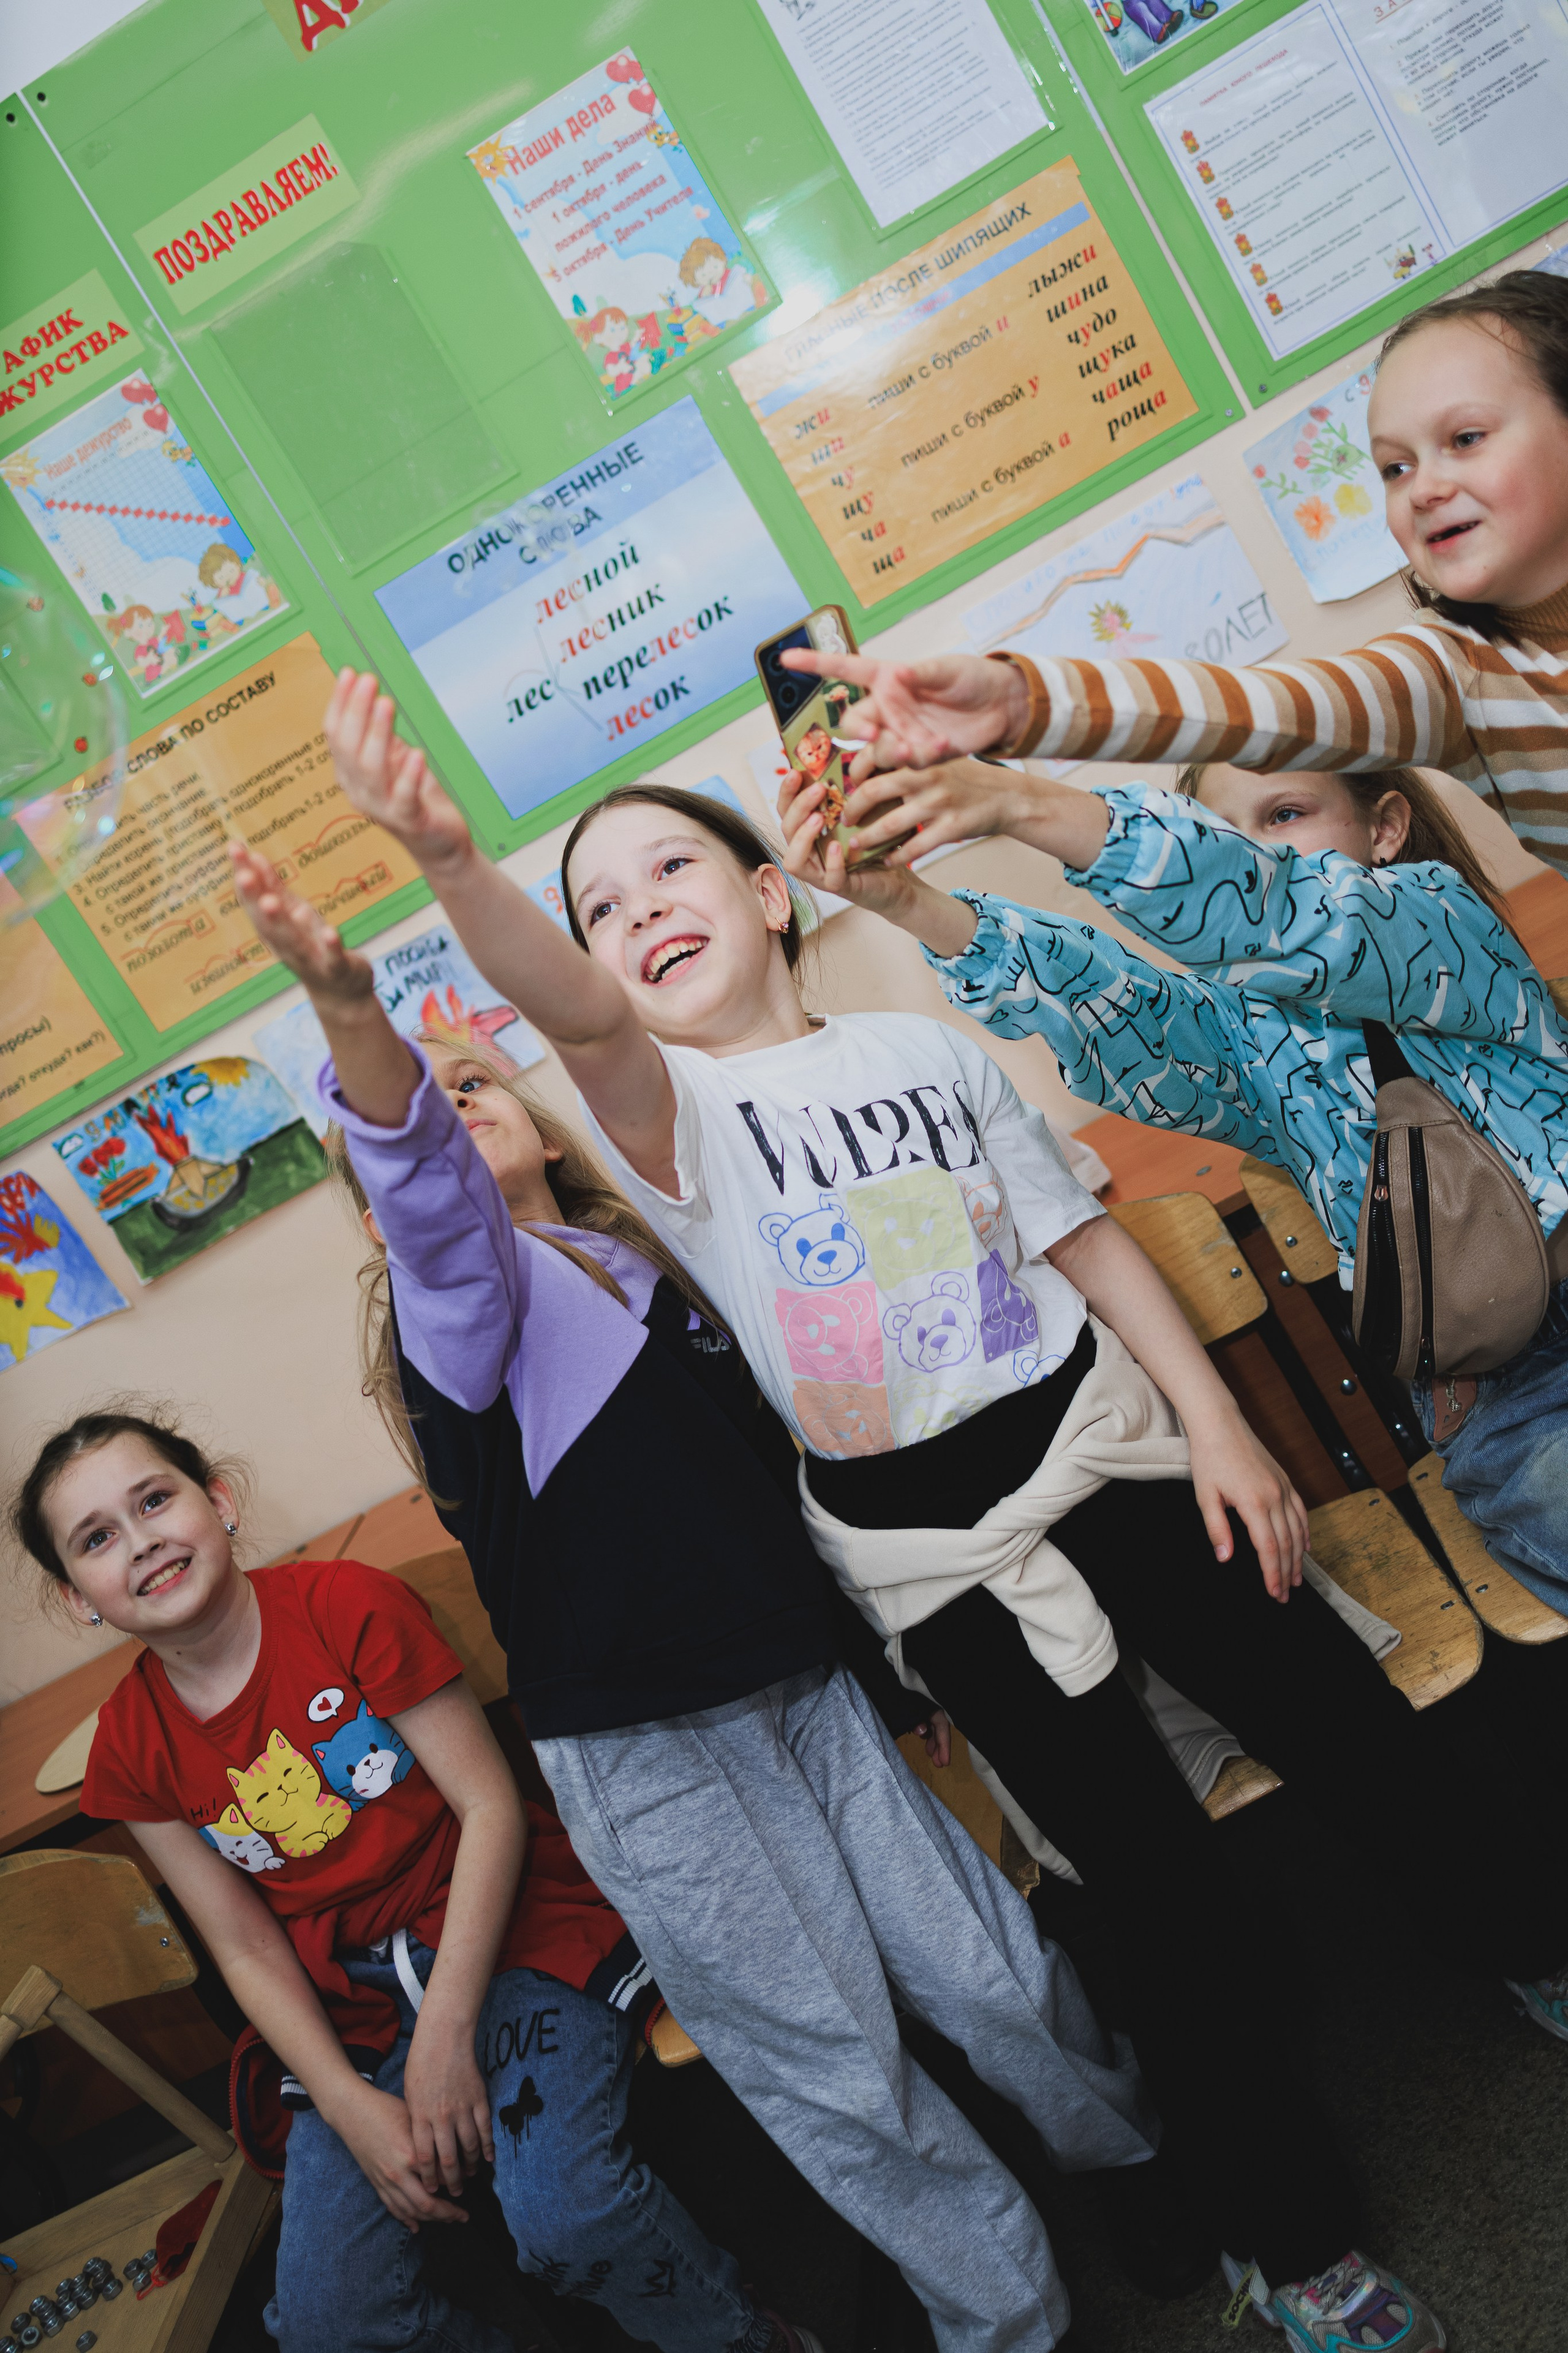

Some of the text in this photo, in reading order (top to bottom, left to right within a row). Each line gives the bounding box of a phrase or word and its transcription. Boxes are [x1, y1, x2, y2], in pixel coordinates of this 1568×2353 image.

[504, 94, 616, 174] Наши дела
[521, 175, 575, 213] сентября
[582, 151, 613, 176] День
[563, 184, 606, 217] октября
[616, 162, 643, 184] день
[156, 146, 336, 282] ПОЗДРАВЛЯЕМ!
[556, 175, 666, 251] пожилого человека
[564, 240, 608, 276] октября
[615, 221, 645, 244] День
[645, 186, 694, 221] Учителя
[936, 203, 1031, 269] ШИПЯЩИХ
[1030, 246, 1096, 297] лыжи
[1047, 276, 1108, 322] шина
[4, 310, 82, 373] АФИК
[930, 326, 992, 369] буквой
[1068, 309, 1117, 346] чудо
[1079, 334, 1136, 377] щука
[1093, 363, 1152, 403] чаща
[902, 433, 948, 466] пиши
[965, 385, 1025, 428] буквой
[1027, 375, 1040, 398] у
[1108, 391, 1166, 440] роща
[932, 489, 978, 522] пиши
[993, 442, 1054, 483] буквой
[1058, 431, 1072, 449] а
[861, 521, 886, 542] ча
[539, 543, 638, 622] лесной
[873, 548, 905, 574] ща
[564, 585, 663, 661] лесник
[584, 599, 731, 699] перелесок
[127, 737, 176, 772] СЛОВА
[180, 719, 204, 738] ПО
[206, 673, 274, 723] СОСТАВУ
[509, 680, 552, 722] лес
[609, 677, 689, 740] лесок
[96, 858, 163, 899] Определить
[124, 839, 162, 863] корень
[115, 885, 183, 926] Определить
[690, 1336, 730, 1353] FILA
[190, 1797, 217, 1819] Hi!
[483, 2008, 560, 2078] LOVE
